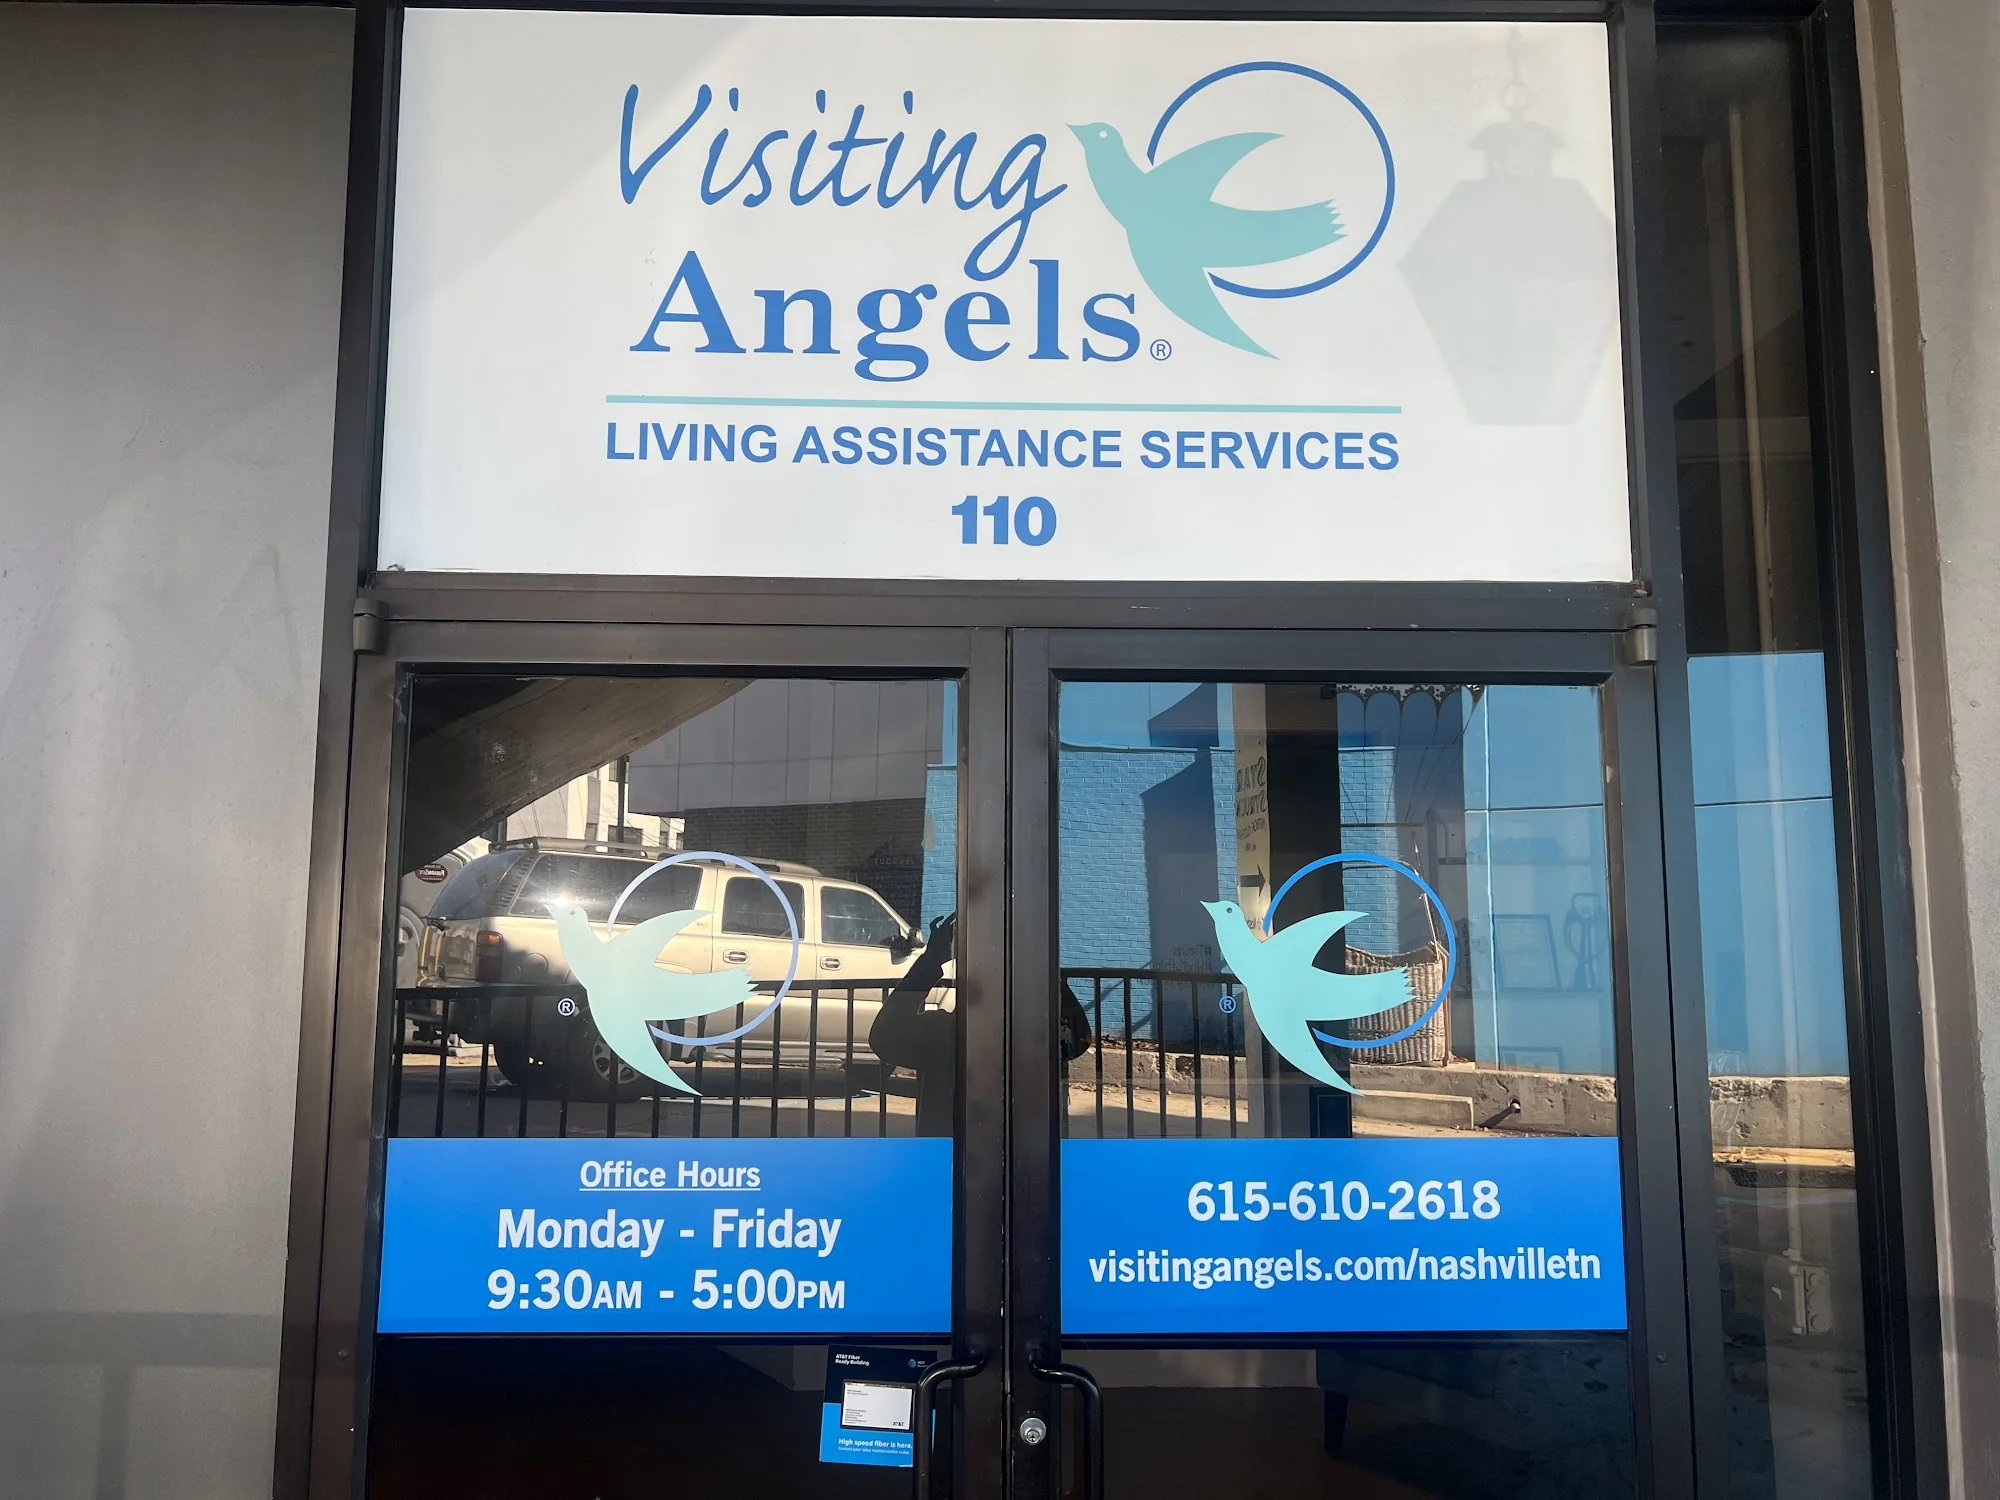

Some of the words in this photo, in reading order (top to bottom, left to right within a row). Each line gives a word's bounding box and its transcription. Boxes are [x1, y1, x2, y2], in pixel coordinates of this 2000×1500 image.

[621, 86, 1066, 281] Visiting
[631, 252, 1139, 382] Angels
[608, 422, 777, 464] LIVING
[794, 425, 1121, 468] ASSISTANCE
[1141, 430, 1399, 471] SERVICES
[952, 496, 1057, 547] 110
[580, 1161, 667, 1192] Office
[678, 1161, 761, 1192] Hours
[1188, 1180, 1501, 1222] 615-610-2618
[498, 1208, 665, 1258] Monday
[679, 1229, 695, 1238] -
[712, 1208, 842, 1258] Friday
[487, 1268, 642, 1310] 9:30AM
[659, 1290, 674, 1299] -
[691, 1268, 845, 1310] 5:00PM
[1089, 1248, 1601, 1290] visitingangels.com/nashvilletn
[838, 1438, 853, 1447] High
